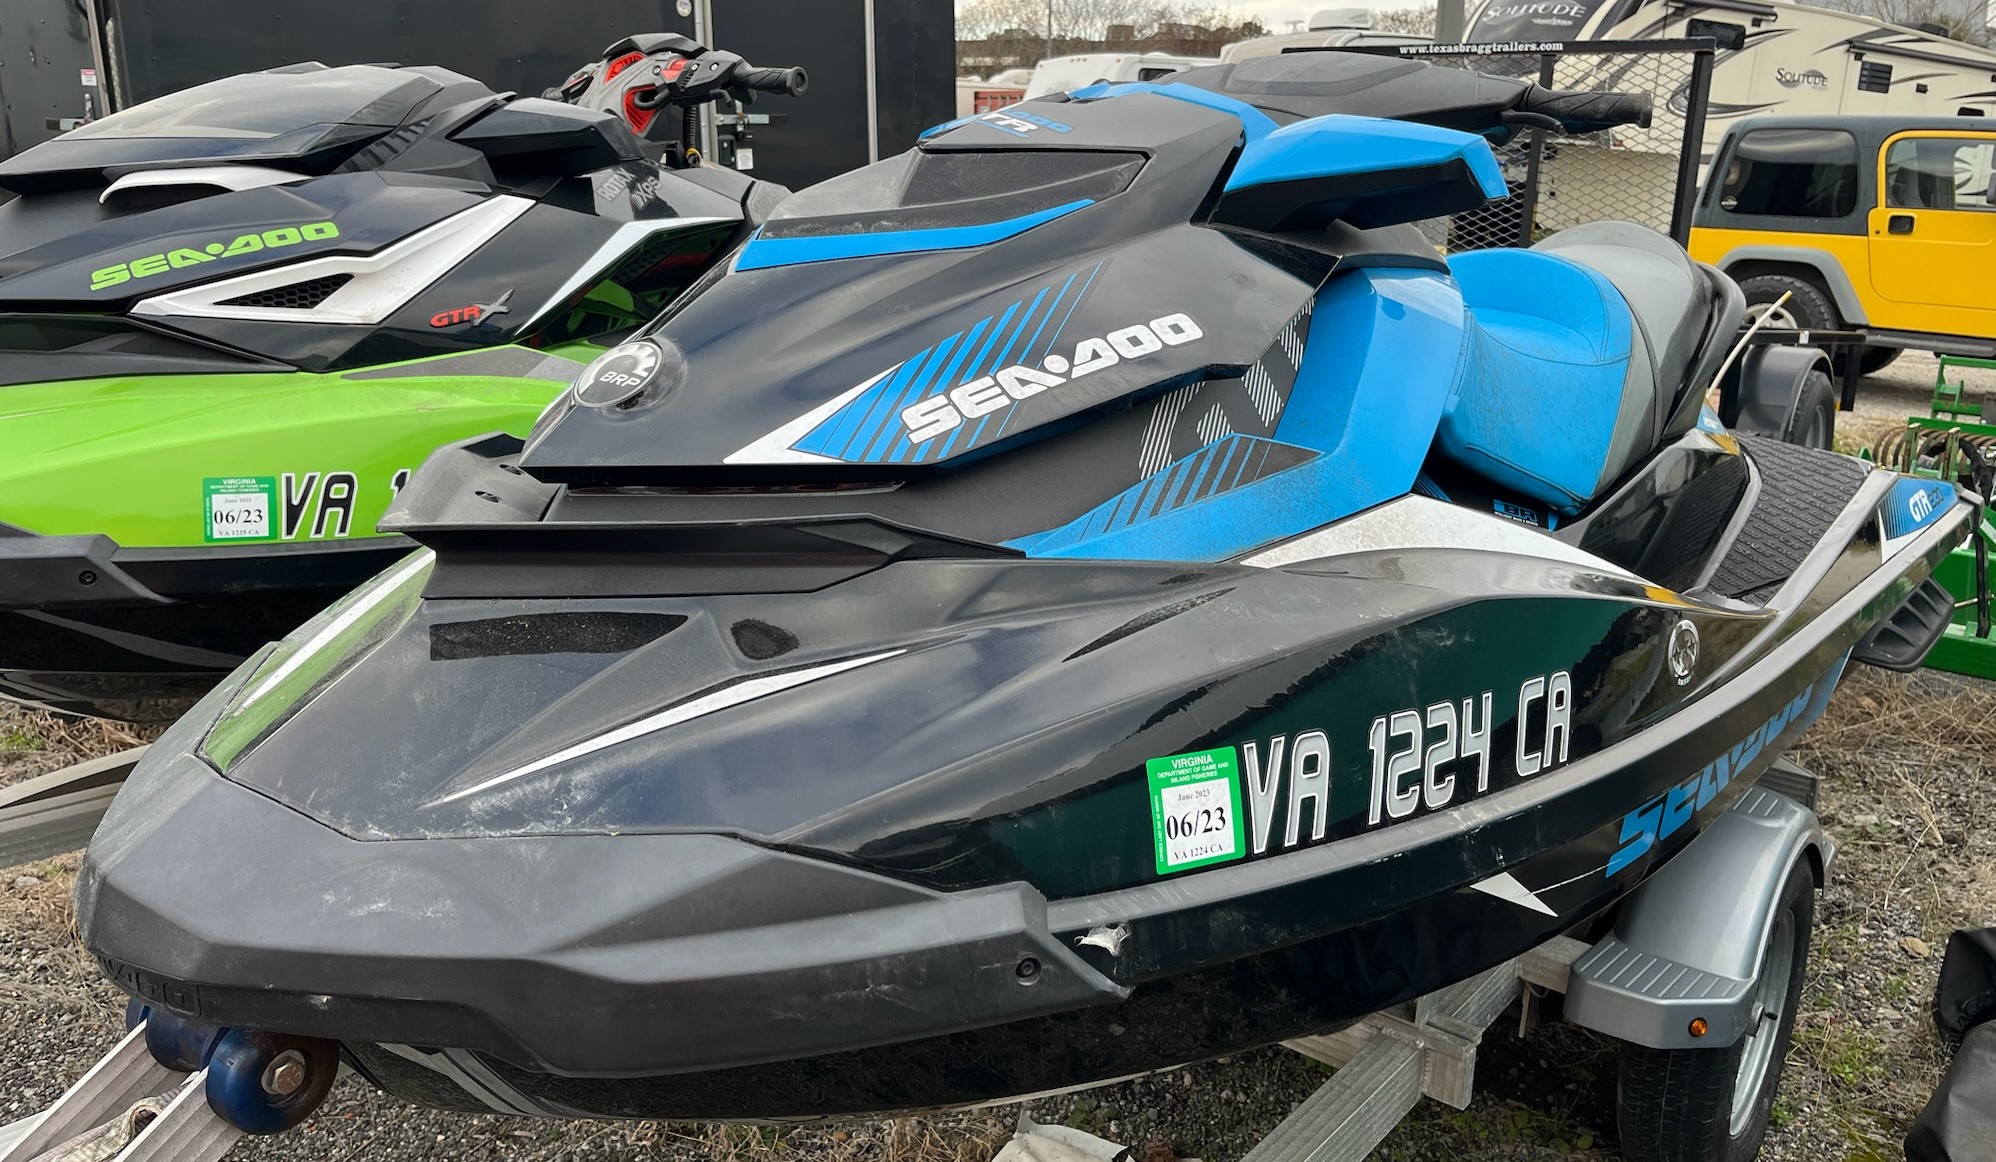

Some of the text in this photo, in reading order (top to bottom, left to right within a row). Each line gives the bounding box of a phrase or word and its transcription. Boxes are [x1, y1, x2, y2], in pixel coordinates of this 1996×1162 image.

[1482, 3, 1586, 21] SOLITUDE
[1399, 41, 1564, 55] www.texasbraggtrailers.com
[1775, 67, 1828, 87] SOLITUDE
[596, 167, 636, 202] ROTAX
[636, 176, 662, 204] XPS
[599, 370, 641, 387] BRP
[281, 471, 358, 540] VA
[1909, 488, 1933, 523] GTR
[213, 508, 263, 525] 06/23
[1157, 761, 1229, 779] DEPARTMENT OF GAME AND
[1172, 754, 1213, 769] VIRGINIA
[1243, 670, 1572, 855] VA 1224 CA
[1170, 775, 1191, 784] INLAND
[1177, 788, 1211, 802] June 2023
[1166, 806, 1227, 841] 06/23
[1173, 843, 1223, 860] VA 1224 CA
